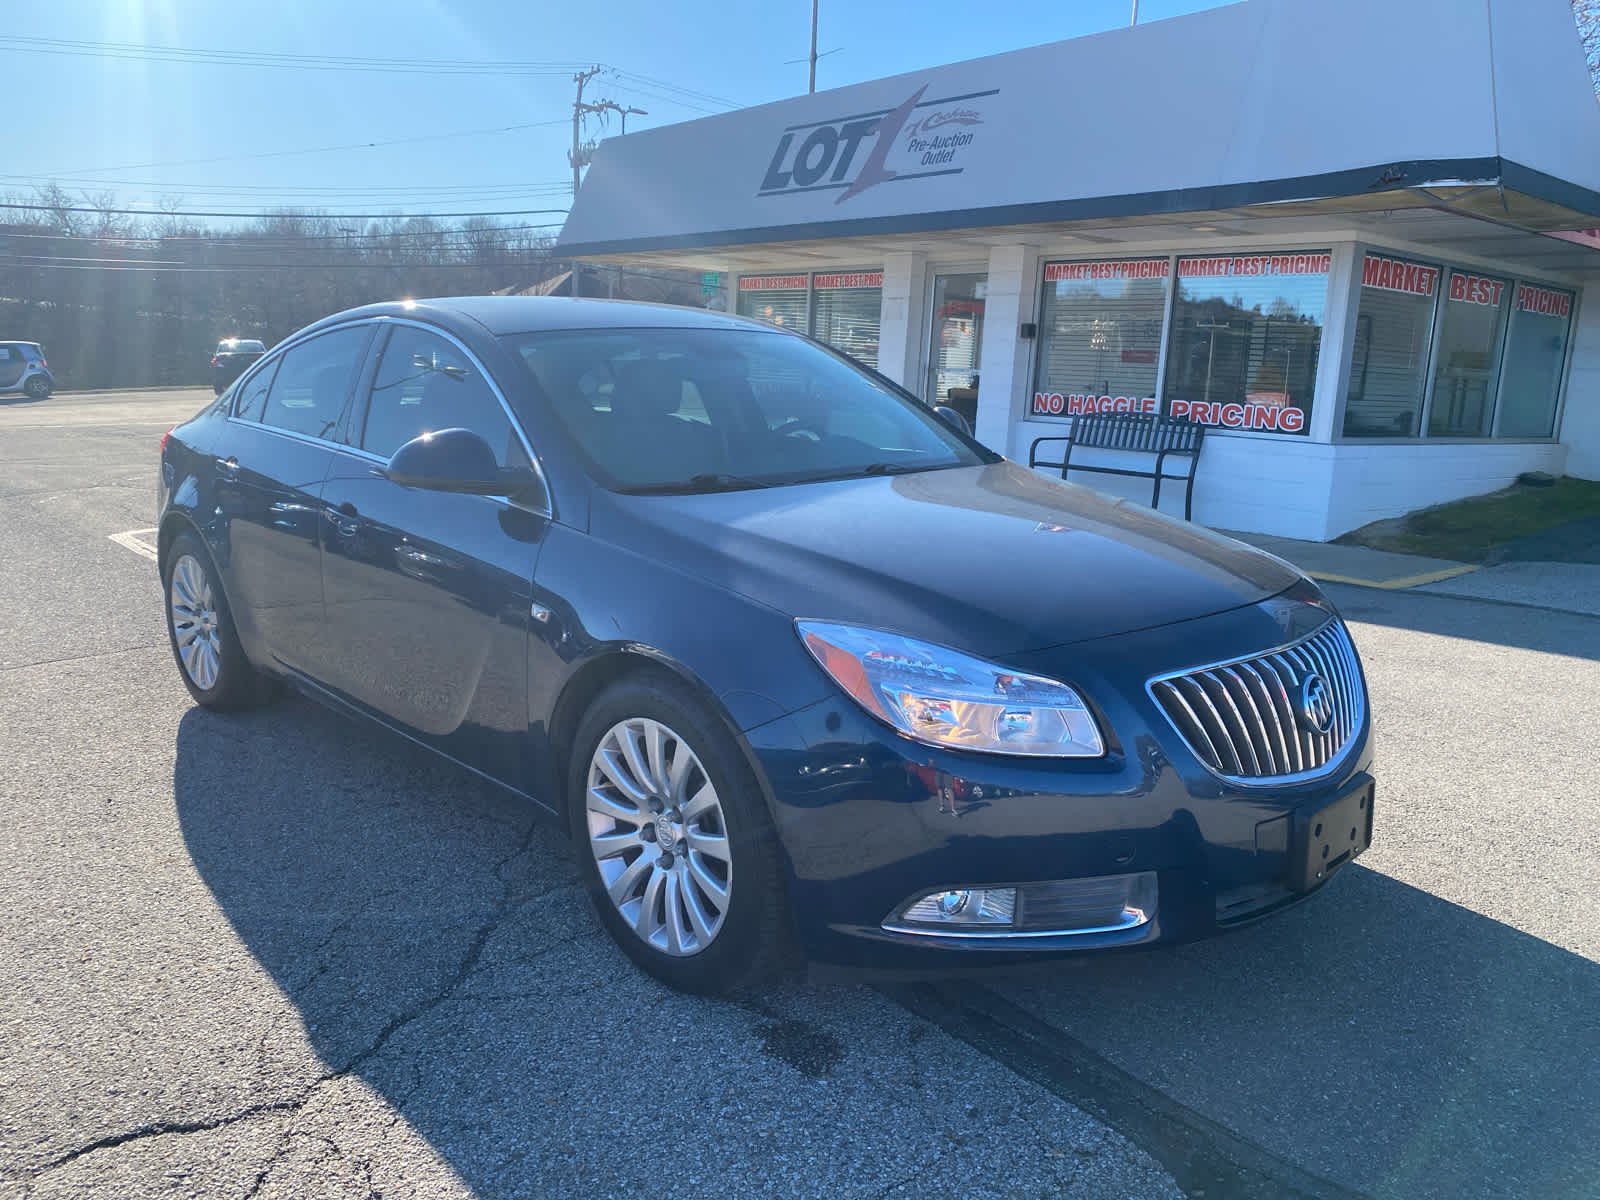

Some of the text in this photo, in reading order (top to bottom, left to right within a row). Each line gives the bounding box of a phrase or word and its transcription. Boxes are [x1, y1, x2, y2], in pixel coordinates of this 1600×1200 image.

[907, 131, 974, 153] Pre-Auction
[760, 117, 882, 191] LOT
[921, 148, 956, 166] Outlet
[1044, 259, 1169, 281] MARKET BEST PRICING
[1178, 254, 1332, 277] MARKET BEST PRICING
[815, 275, 842, 290] MARKET
[844, 274, 862, 288] BEST
[1361, 256, 1570, 317] MARKET BEST PRICING
[1034, 392, 1304, 431] NO HAGGLE PRICING
